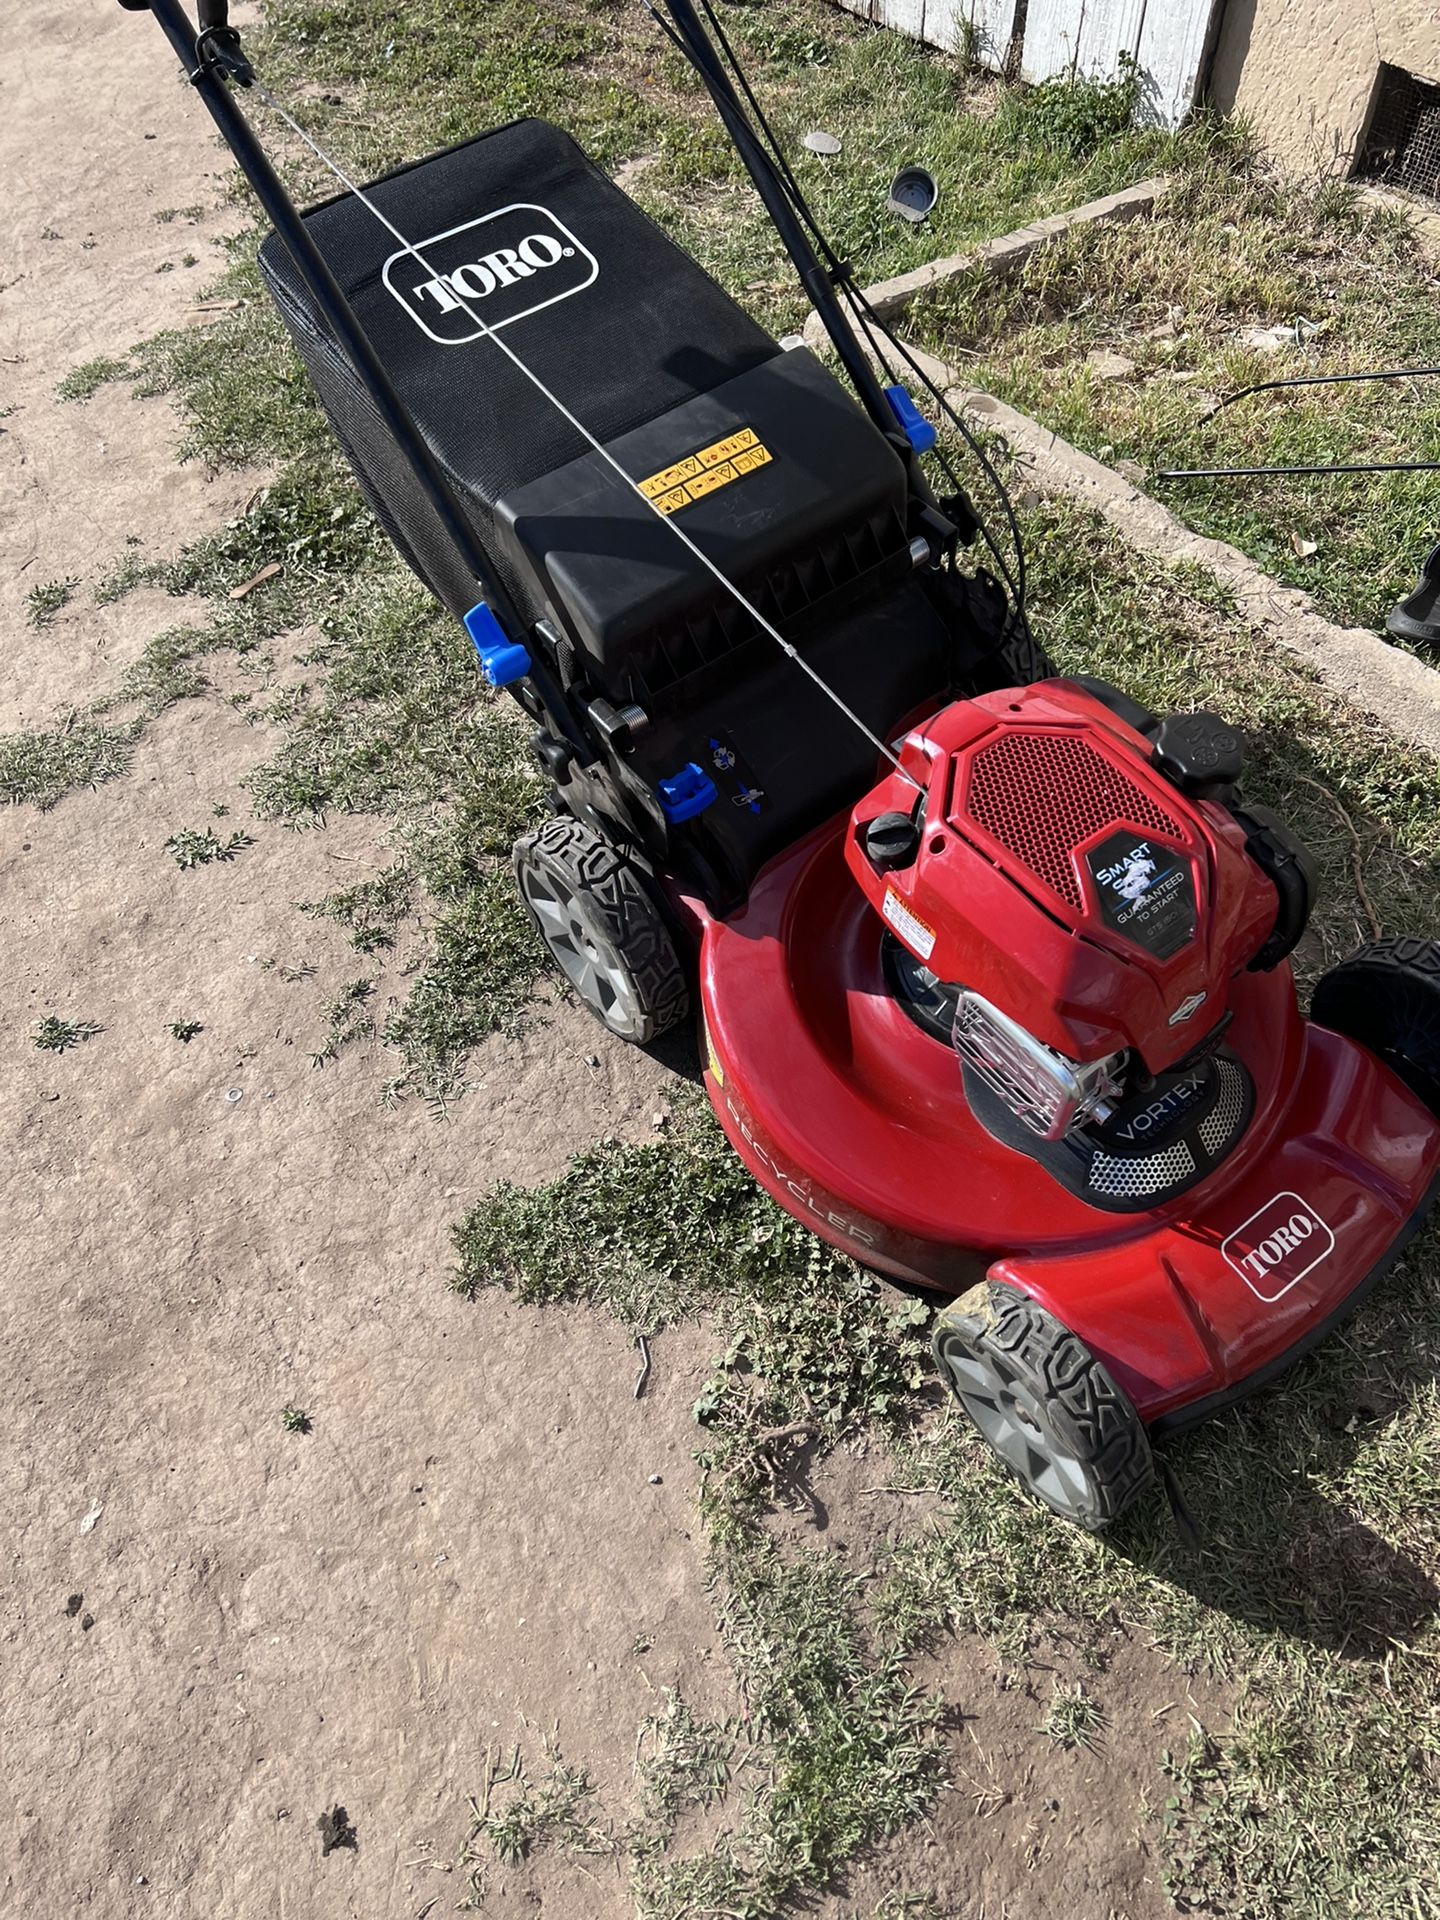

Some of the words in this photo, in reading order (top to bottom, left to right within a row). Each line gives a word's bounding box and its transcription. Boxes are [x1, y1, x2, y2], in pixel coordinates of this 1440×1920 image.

[1096, 842, 1151, 886] SMART
[1137, 911, 1150, 923] TO
[1151, 889, 1179, 914] START
[1116, 1073, 1206, 1140] VORTEX
[727, 1097, 876, 1247] RECYCLER
